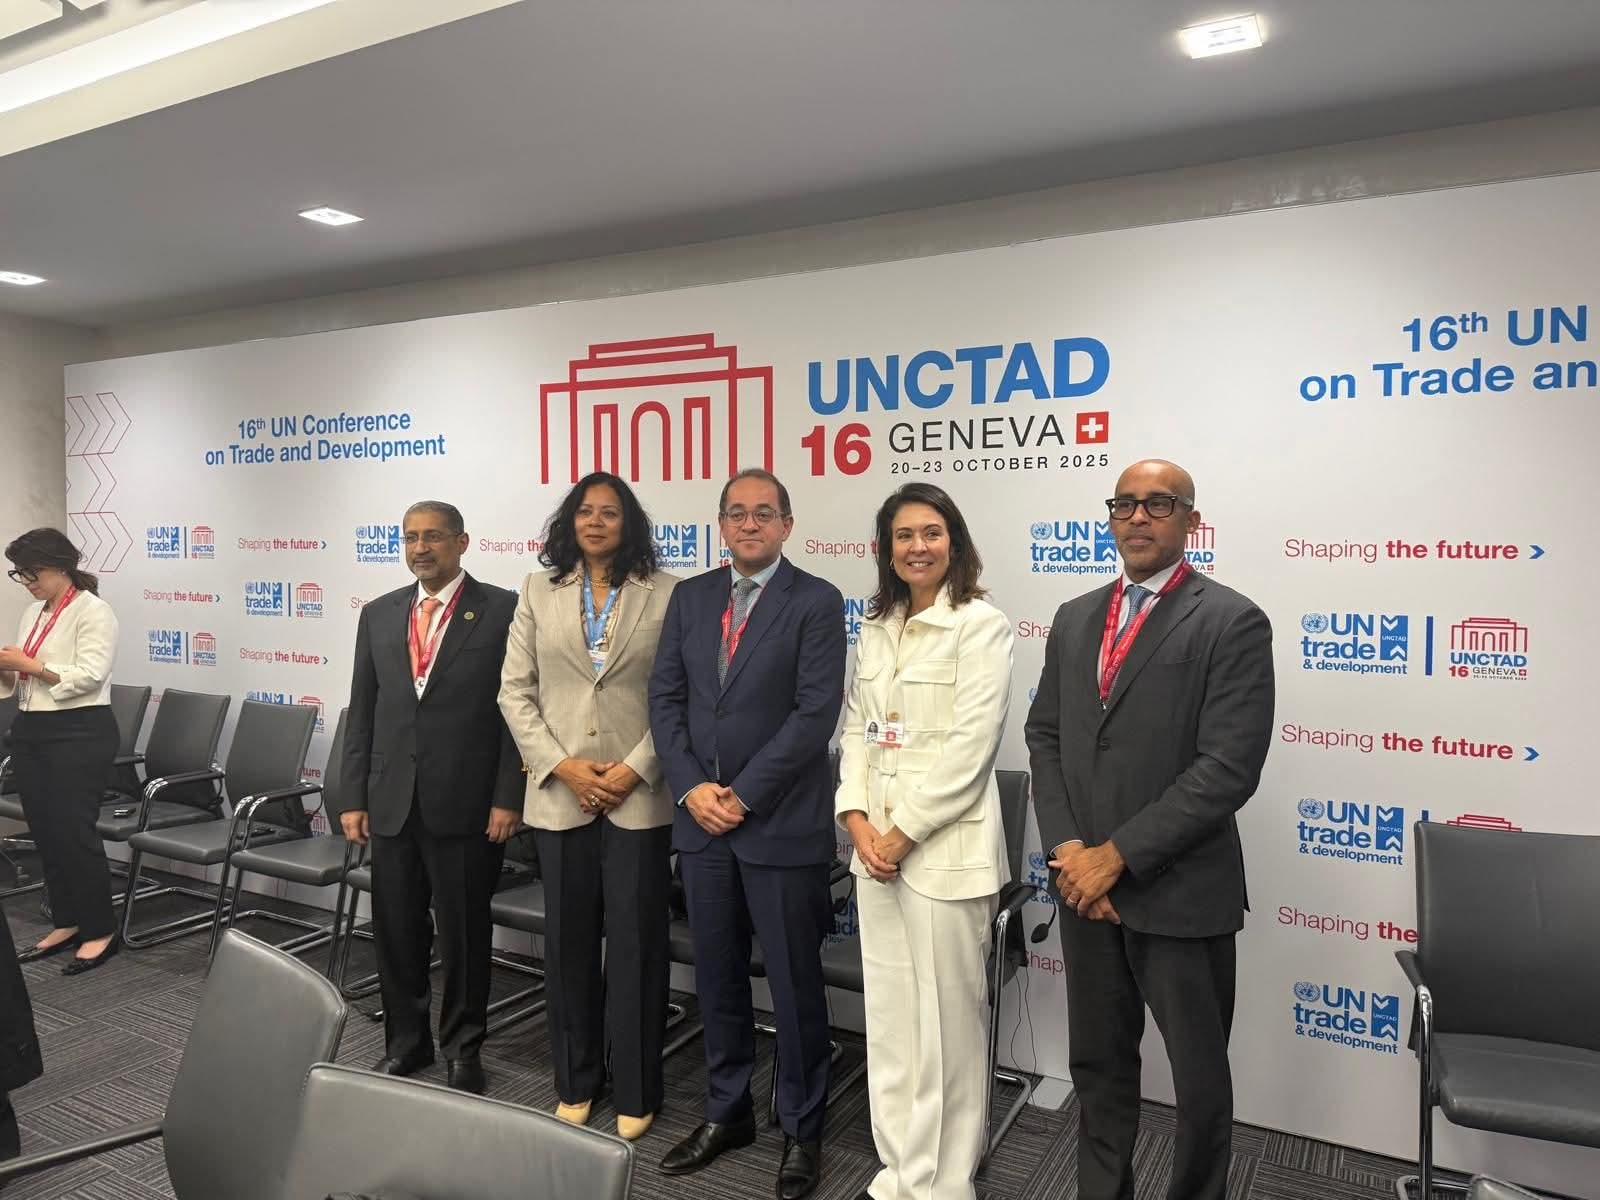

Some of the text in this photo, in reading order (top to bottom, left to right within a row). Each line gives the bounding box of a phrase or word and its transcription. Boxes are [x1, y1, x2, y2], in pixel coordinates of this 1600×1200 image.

[1402, 305, 1587, 352] 16th UN
[808, 337, 1111, 415] UNCTAD
[1300, 358, 1598, 401] on Trade an
[239, 412, 411, 439] 16th UN Conference
[206, 434, 445, 465] on Trade and Development
[801, 414, 1065, 476] 16 GENEVA
[953, 456, 1048, 472] OCTOBER
[1060, 454, 1108, 468] 2025
[156, 527, 169, 539] UN
[368, 525, 385, 539] UN
[655, 525, 678, 540] UN
[1054, 521, 1089, 541] UN
[147, 540, 170, 551] trade
[273, 539, 288, 549] the
[290, 538, 318, 549] future
[356, 540, 386, 553] trade
[480, 539, 523, 554] Shaping
[806, 539, 865, 558] Shaping
[1030, 541, 1089, 562] trade
[1284, 539, 1519, 563] Shaping the future
[1185, 551, 1214, 563] TAD
[1032, 563, 1117, 575] & development
[189, 591, 213, 602] future
[255, 582, 270, 595] UN
[246, 595, 272, 608] trade
[1331, 613, 1374, 636] UN
[158, 630, 171, 643] UN
[149, 643, 171, 655] trade
[275, 651, 289, 662] the
[292, 652, 320, 664] future
[1301, 636, 1375, 660] trade
[1303, 658, 1407, 675] & development
[1451, 652, 1527, 667] UNCTAD
[1449, 665, 1517, 677] 16 GENEVA
[1281, 724, 1513, 760] Shaping the future
[1327, 800, 1370, 826] UN
[1297, 820, 1372, 849] trade
[1299, 843, 1403, 866] & development
[1278, 906, 1419, 943] Shaping the
[1322, 984, 1365, 1012] UN
[1293, 1002, 1367, 1034] trade
[1295, 1024, 1398, 1054] & development
